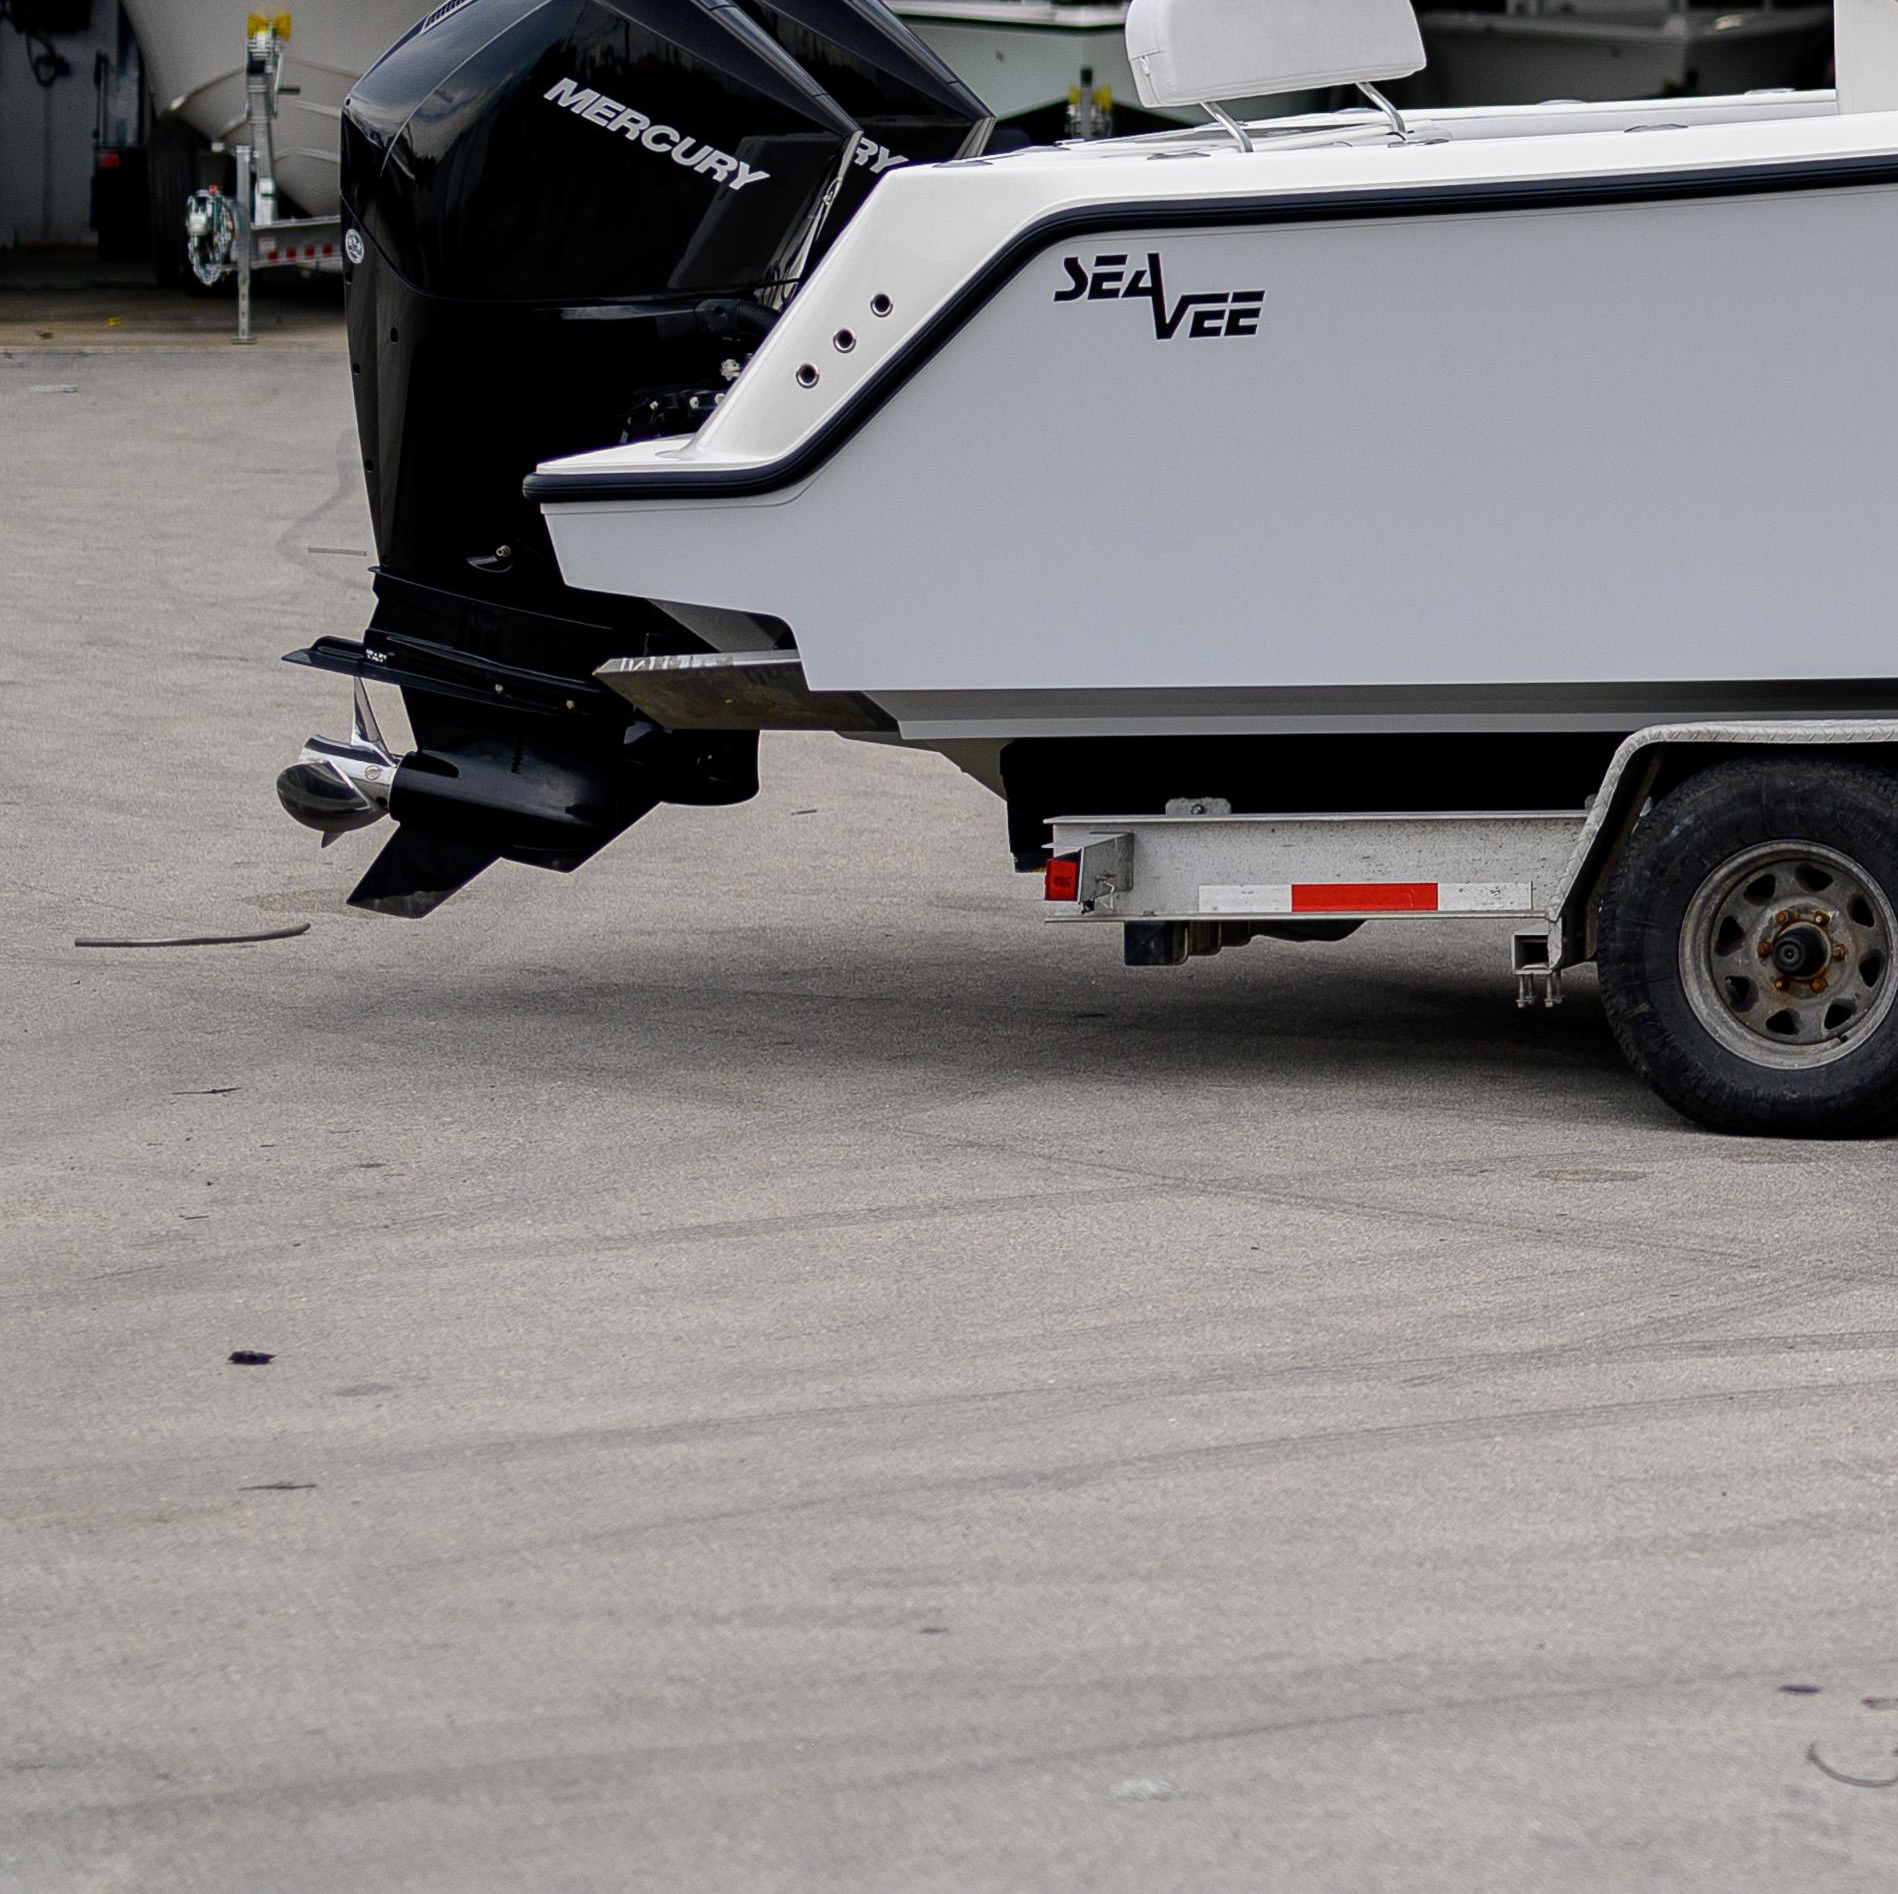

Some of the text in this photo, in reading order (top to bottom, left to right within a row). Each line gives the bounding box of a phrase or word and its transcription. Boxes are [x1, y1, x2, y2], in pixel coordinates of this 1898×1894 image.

[543, 77, 771, 190] MERCURY
[1054, 253, 1265, 340] SEA VEE
